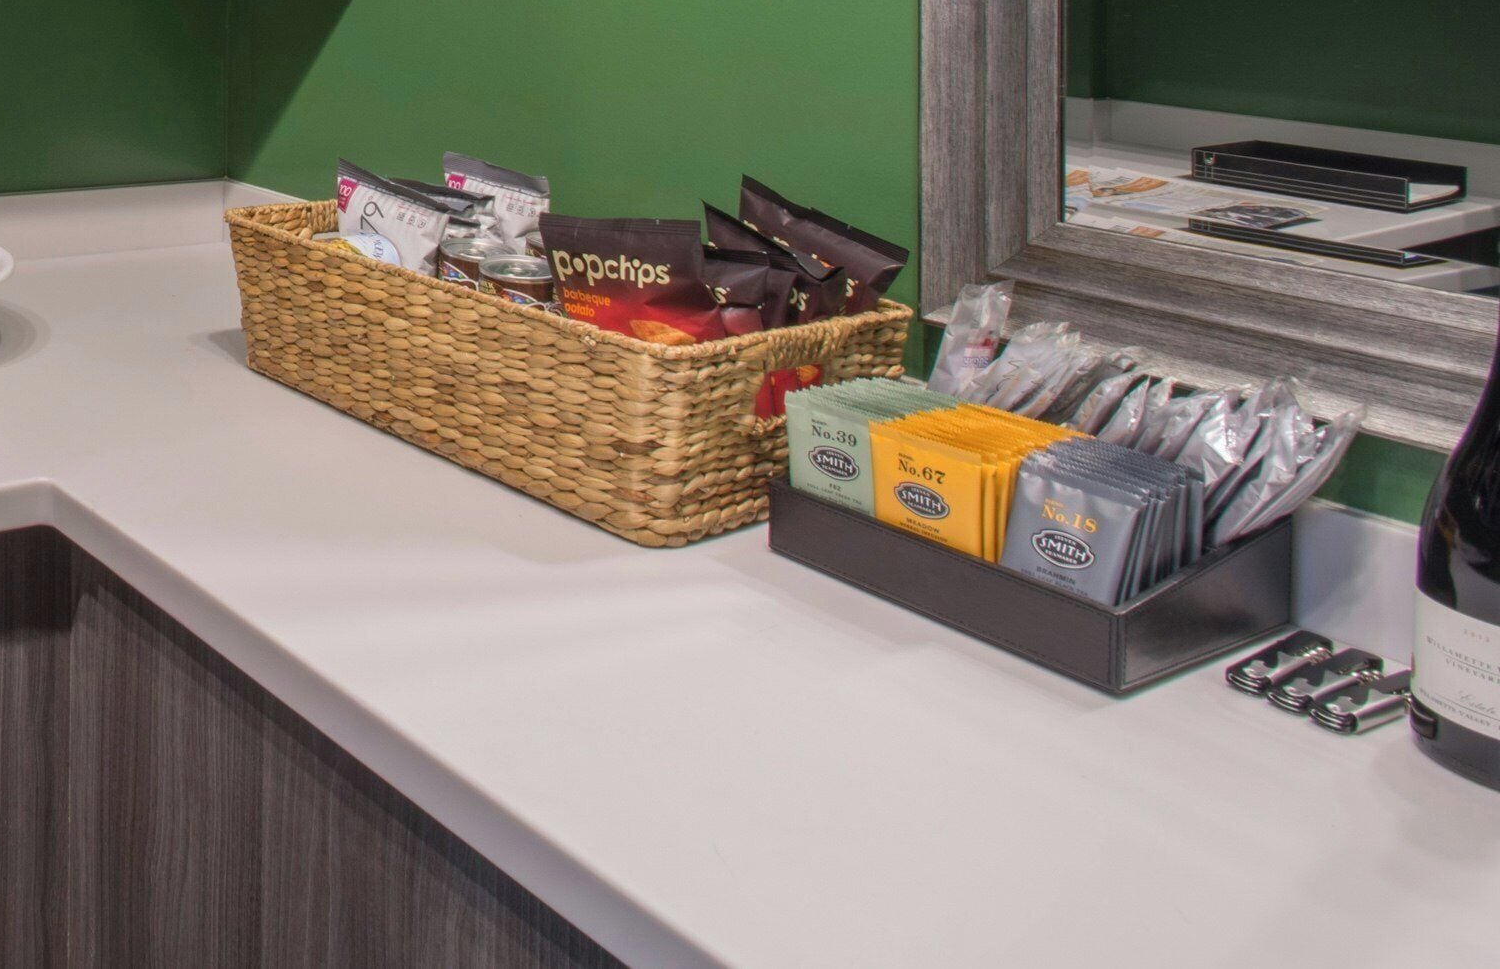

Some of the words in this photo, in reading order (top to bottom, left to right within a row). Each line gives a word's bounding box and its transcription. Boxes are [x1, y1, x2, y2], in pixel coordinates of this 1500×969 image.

[552, 248, 671, 289] popchips
[563, 287, 611, 307] barbeque
[811, 425, 857, 447] No.39
[816, 454, 854, 474] SMITH
[898, 459, 946, 485] No.67
[901, 490, 943, 513] SMITH
[906, 517, 940, 534] MEADOW
[1039, 537, 1086, 562] SMITH
[1036, 566, 1076, 585] BRAHMIN
